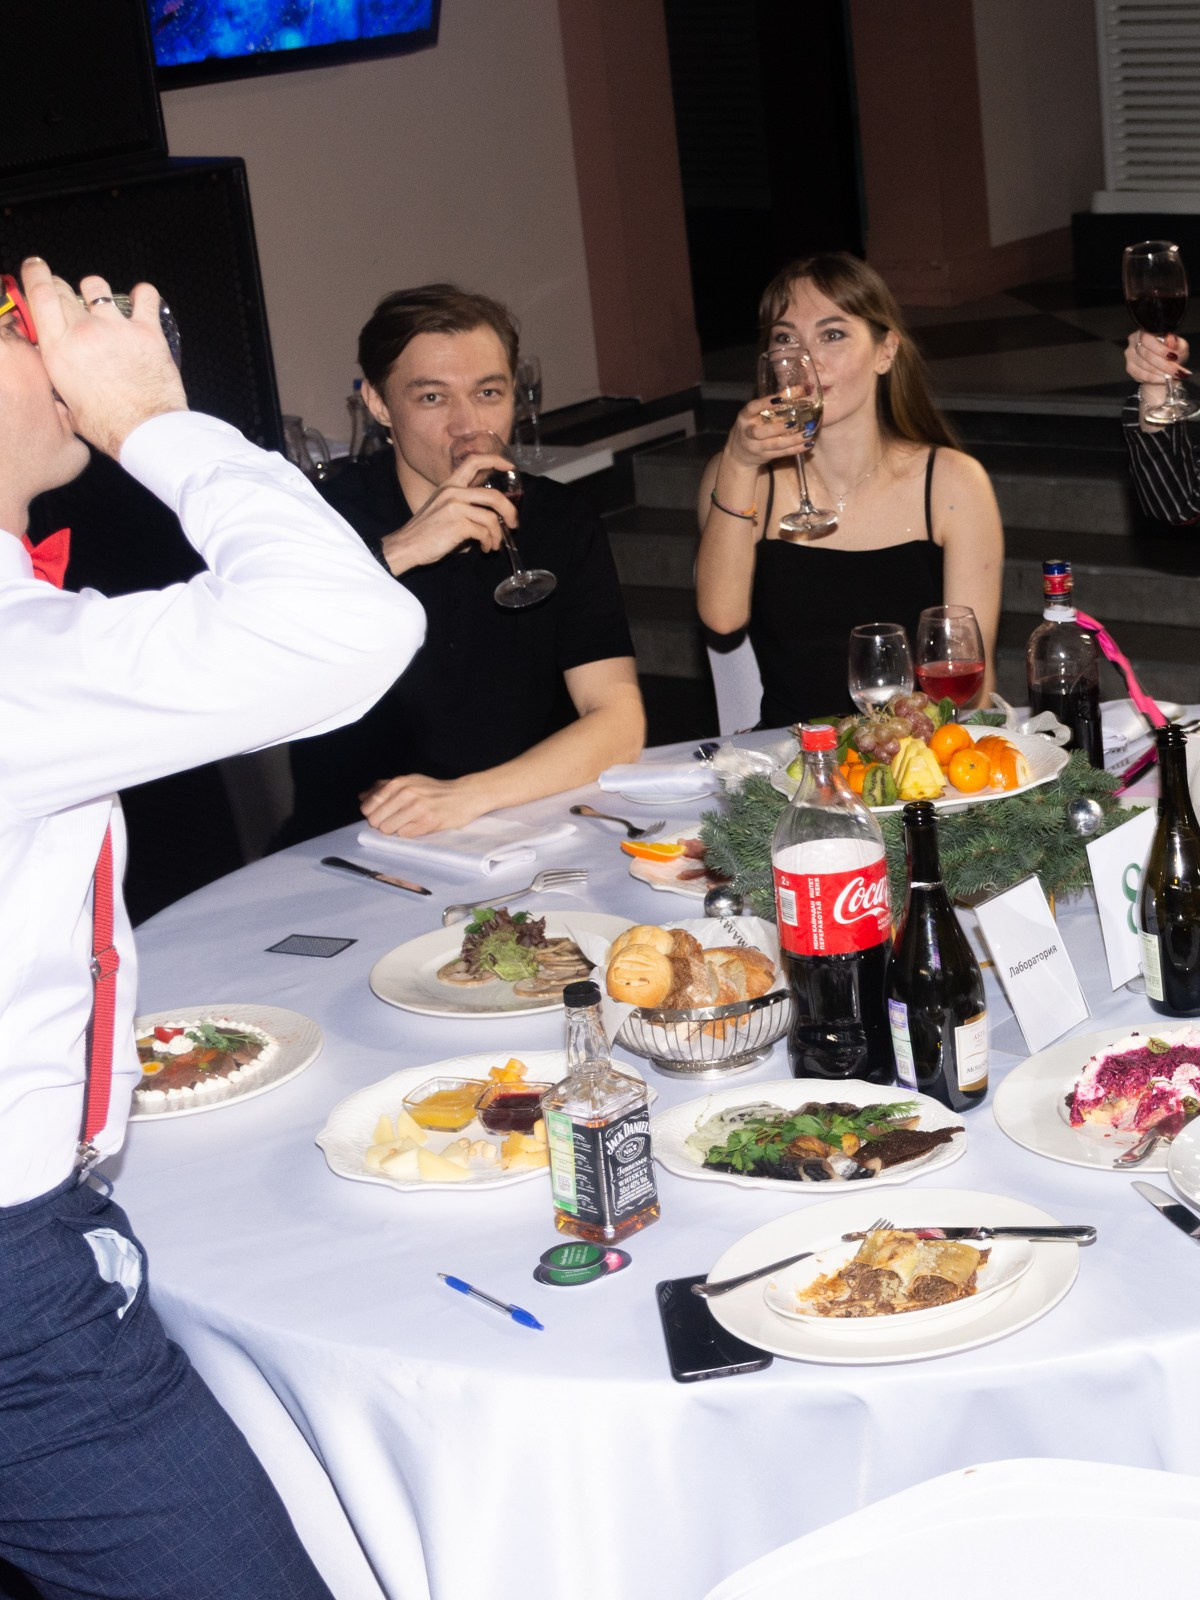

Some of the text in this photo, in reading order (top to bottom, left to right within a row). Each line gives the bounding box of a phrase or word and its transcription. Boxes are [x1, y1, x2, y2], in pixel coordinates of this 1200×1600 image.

[815, 901, 825, 950] ПЕРЕРАБОТАЙ
[1009, 944, 1058, 978] Лаборатория
[605, 1129, 625, 1155] JACK
[618, 1167, 648, 1187] WHISKEY
